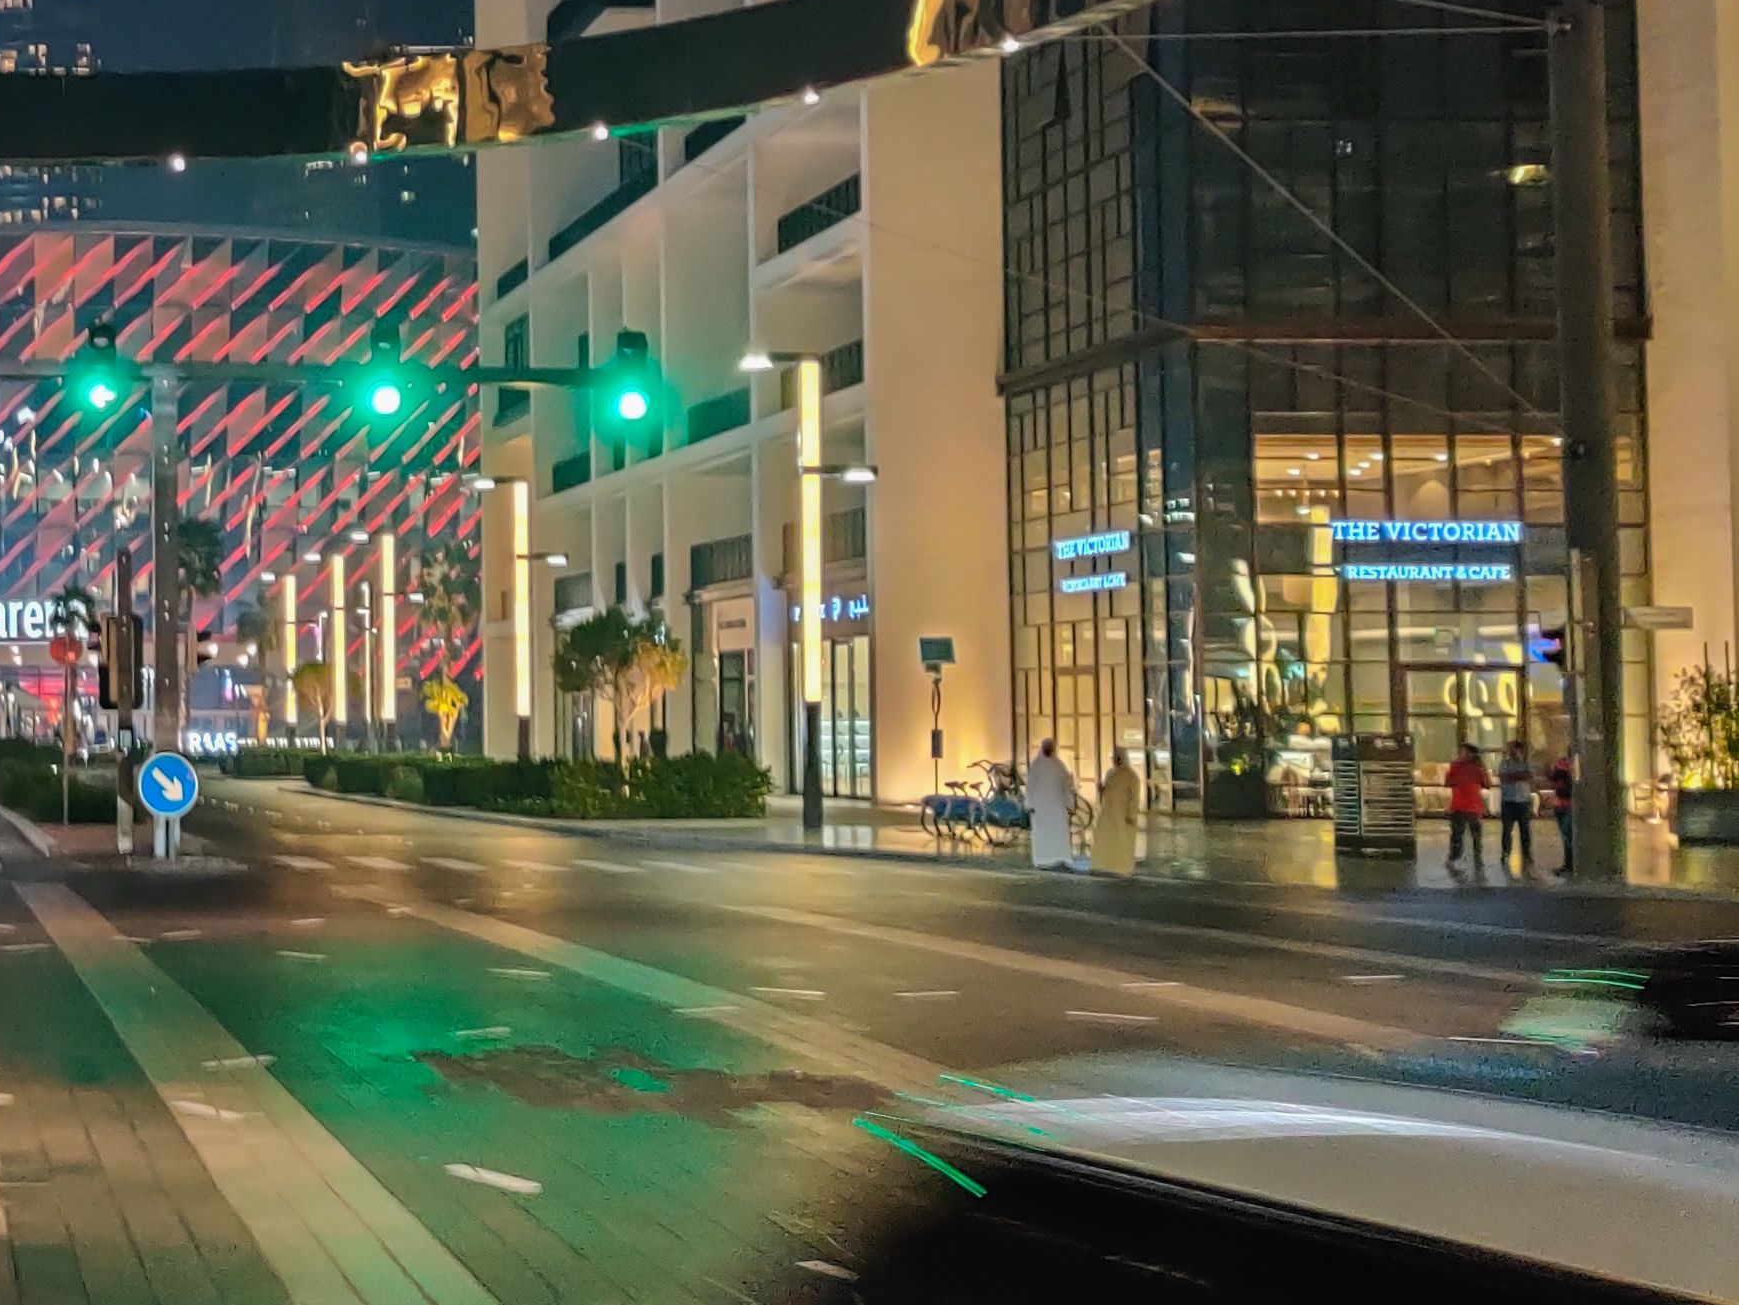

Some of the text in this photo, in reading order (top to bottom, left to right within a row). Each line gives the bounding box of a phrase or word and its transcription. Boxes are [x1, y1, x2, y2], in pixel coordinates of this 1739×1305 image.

[1333, 522, 1522, 542] THE VICTORIAN
[1346, 564, 1455, 580] RESTAURANT
[1456, 565, 1468, 579] &
